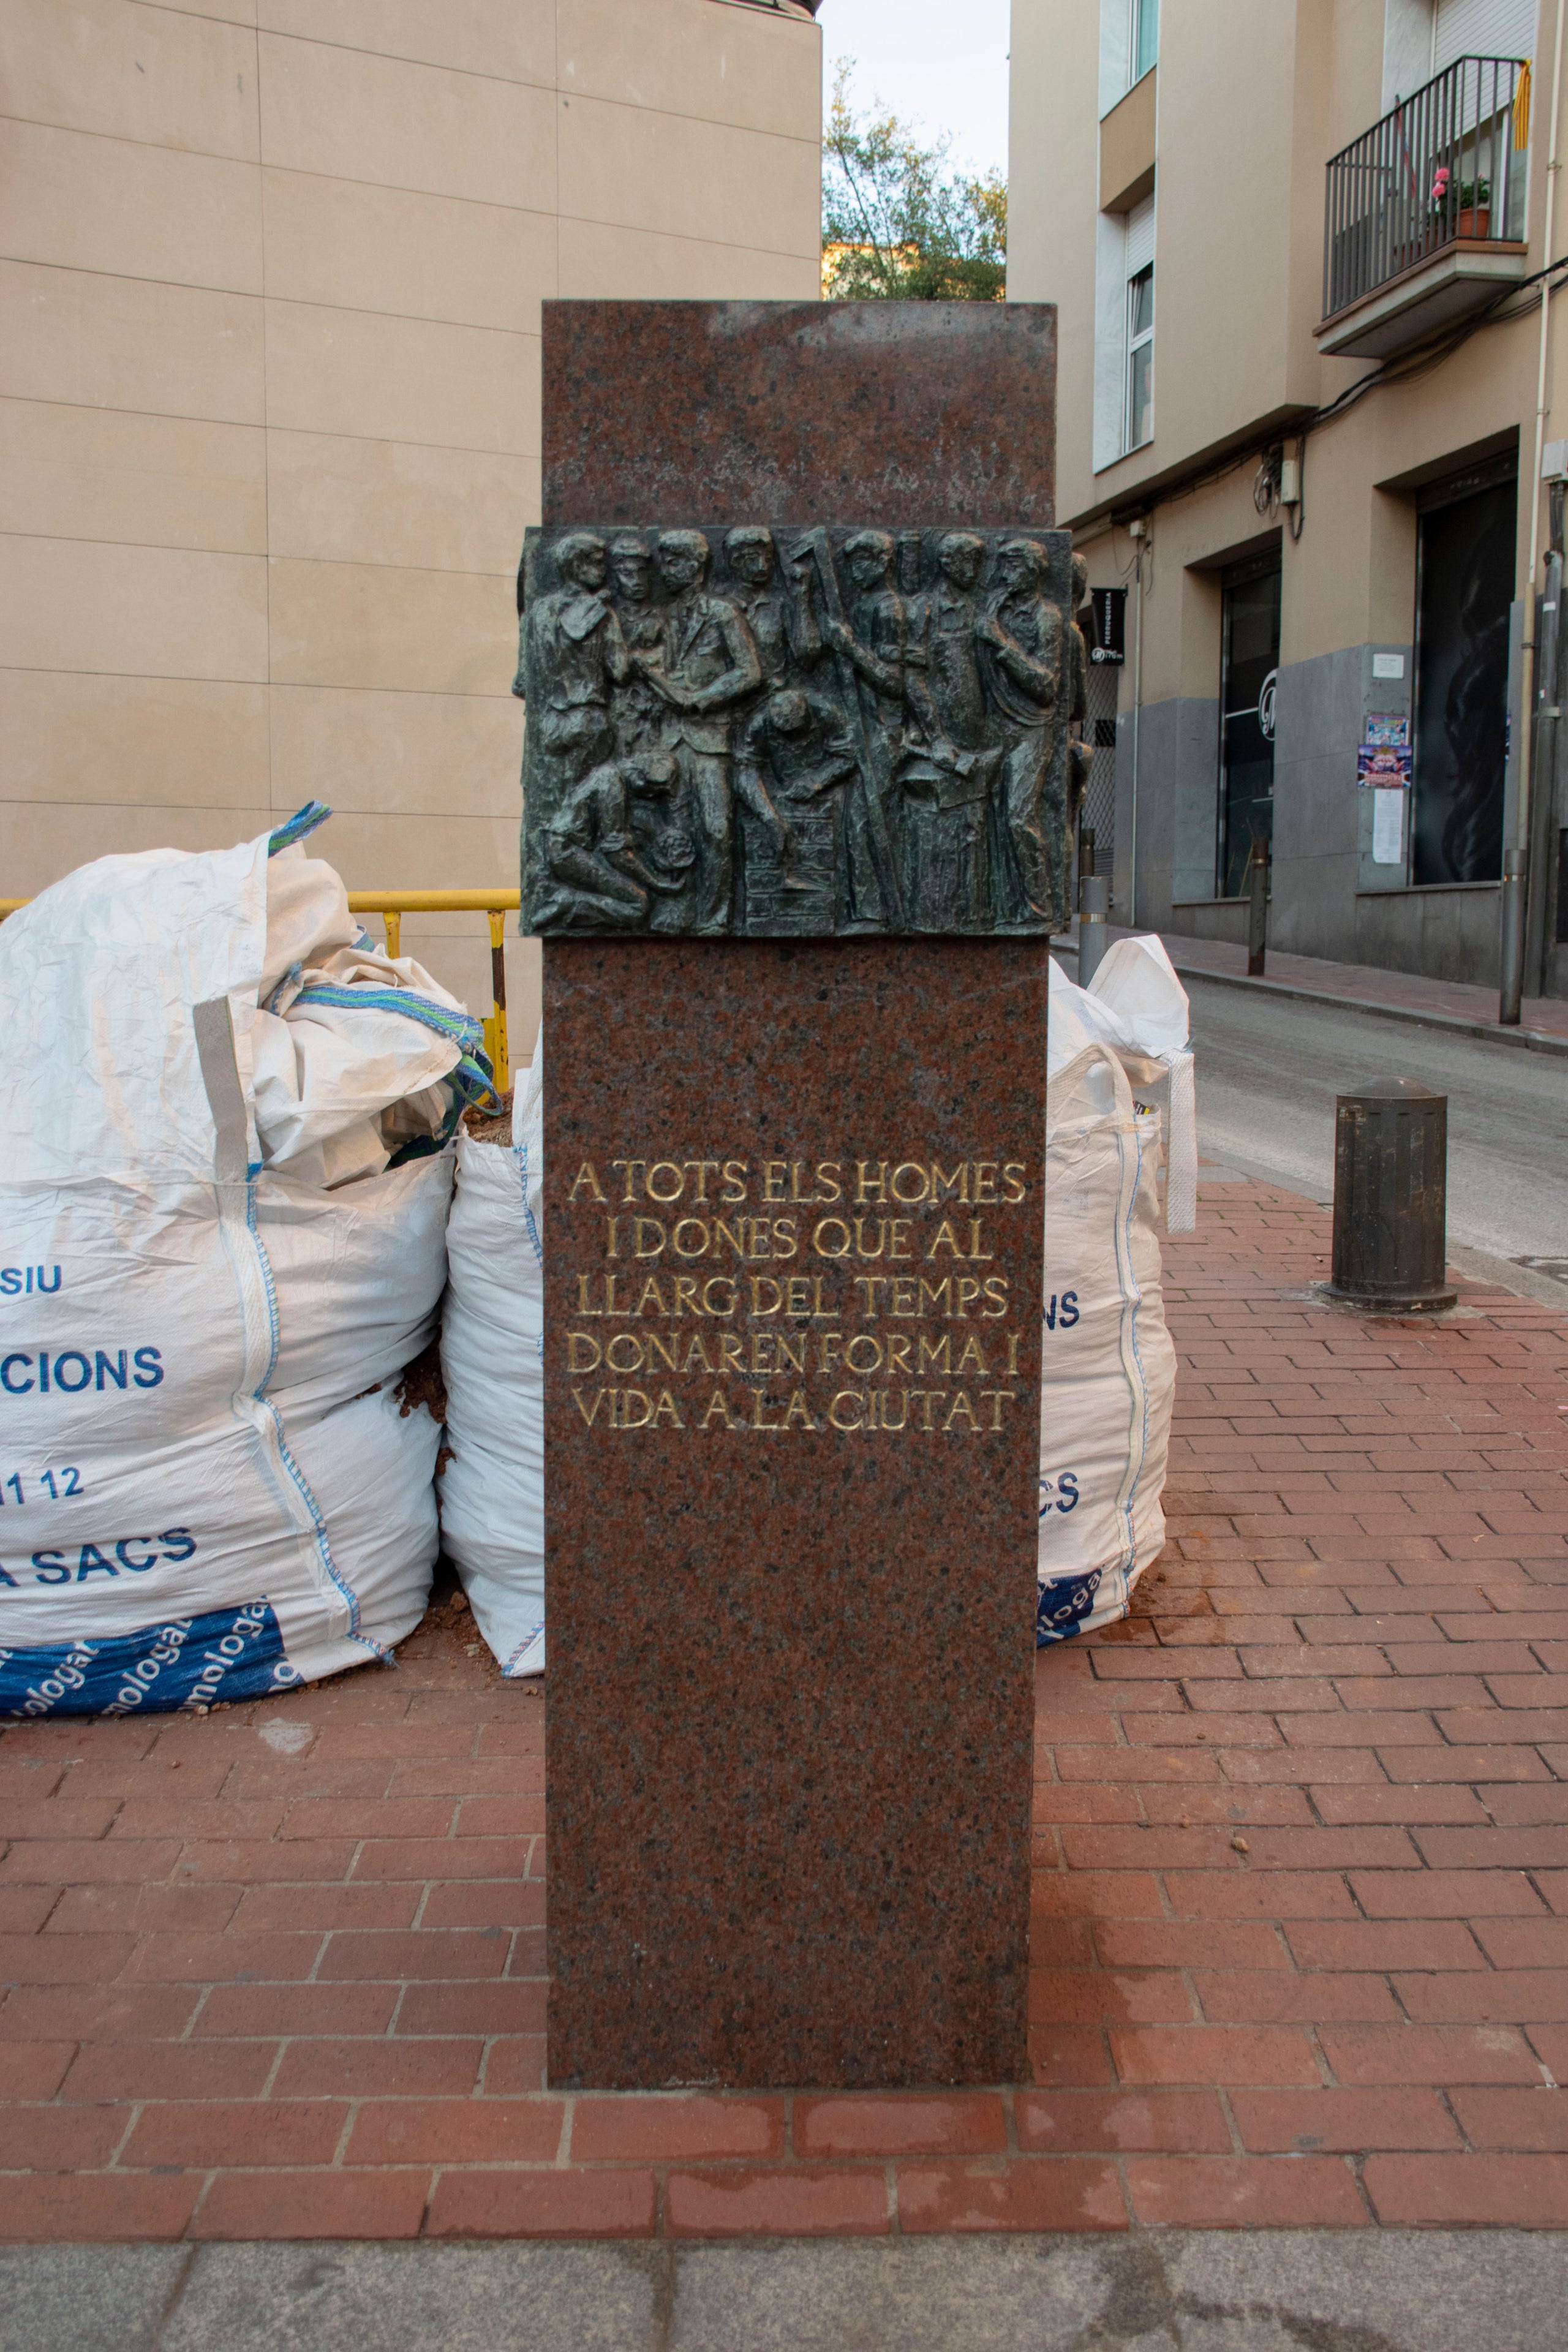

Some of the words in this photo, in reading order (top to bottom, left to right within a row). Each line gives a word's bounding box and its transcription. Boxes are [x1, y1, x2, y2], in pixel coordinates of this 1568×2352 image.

[566, 1162, 608, 1202] A
[612, 1160, 747, 1202] TOTS
[761, 1161, 842, 1202] ELS
[853, 1161, 1027, 1204] HOMES
[606, 1216, 618, 1257] I
[634, 1216, 797, 1259] DONES
[813, 1217, 913, 1259] QUE
[925, 1218, 993, 1260] AL
[575, 1274, 738, 1316] LLARG
[749, 1275, 840, 1317] DEL
[853, 1276, 1009, 1317] TEMPS
[0, 1346, 165, 1394] CIONS
[566, 1332, 807, 1374] DONAREN
[816, 1332, 992, 1374] FORMA
[1003, 1333, 1020, 1375] I
[571, 1387, 686, 1429] VIDA
[696, 1389, 736, 1430] A
[751, 1387, 817, 1430] LA
[828, 1389, 1016, 1431] CIUTAT
[40, 1466, 84, 1499] 12
[31, 1527, 197, 1585] SACS
